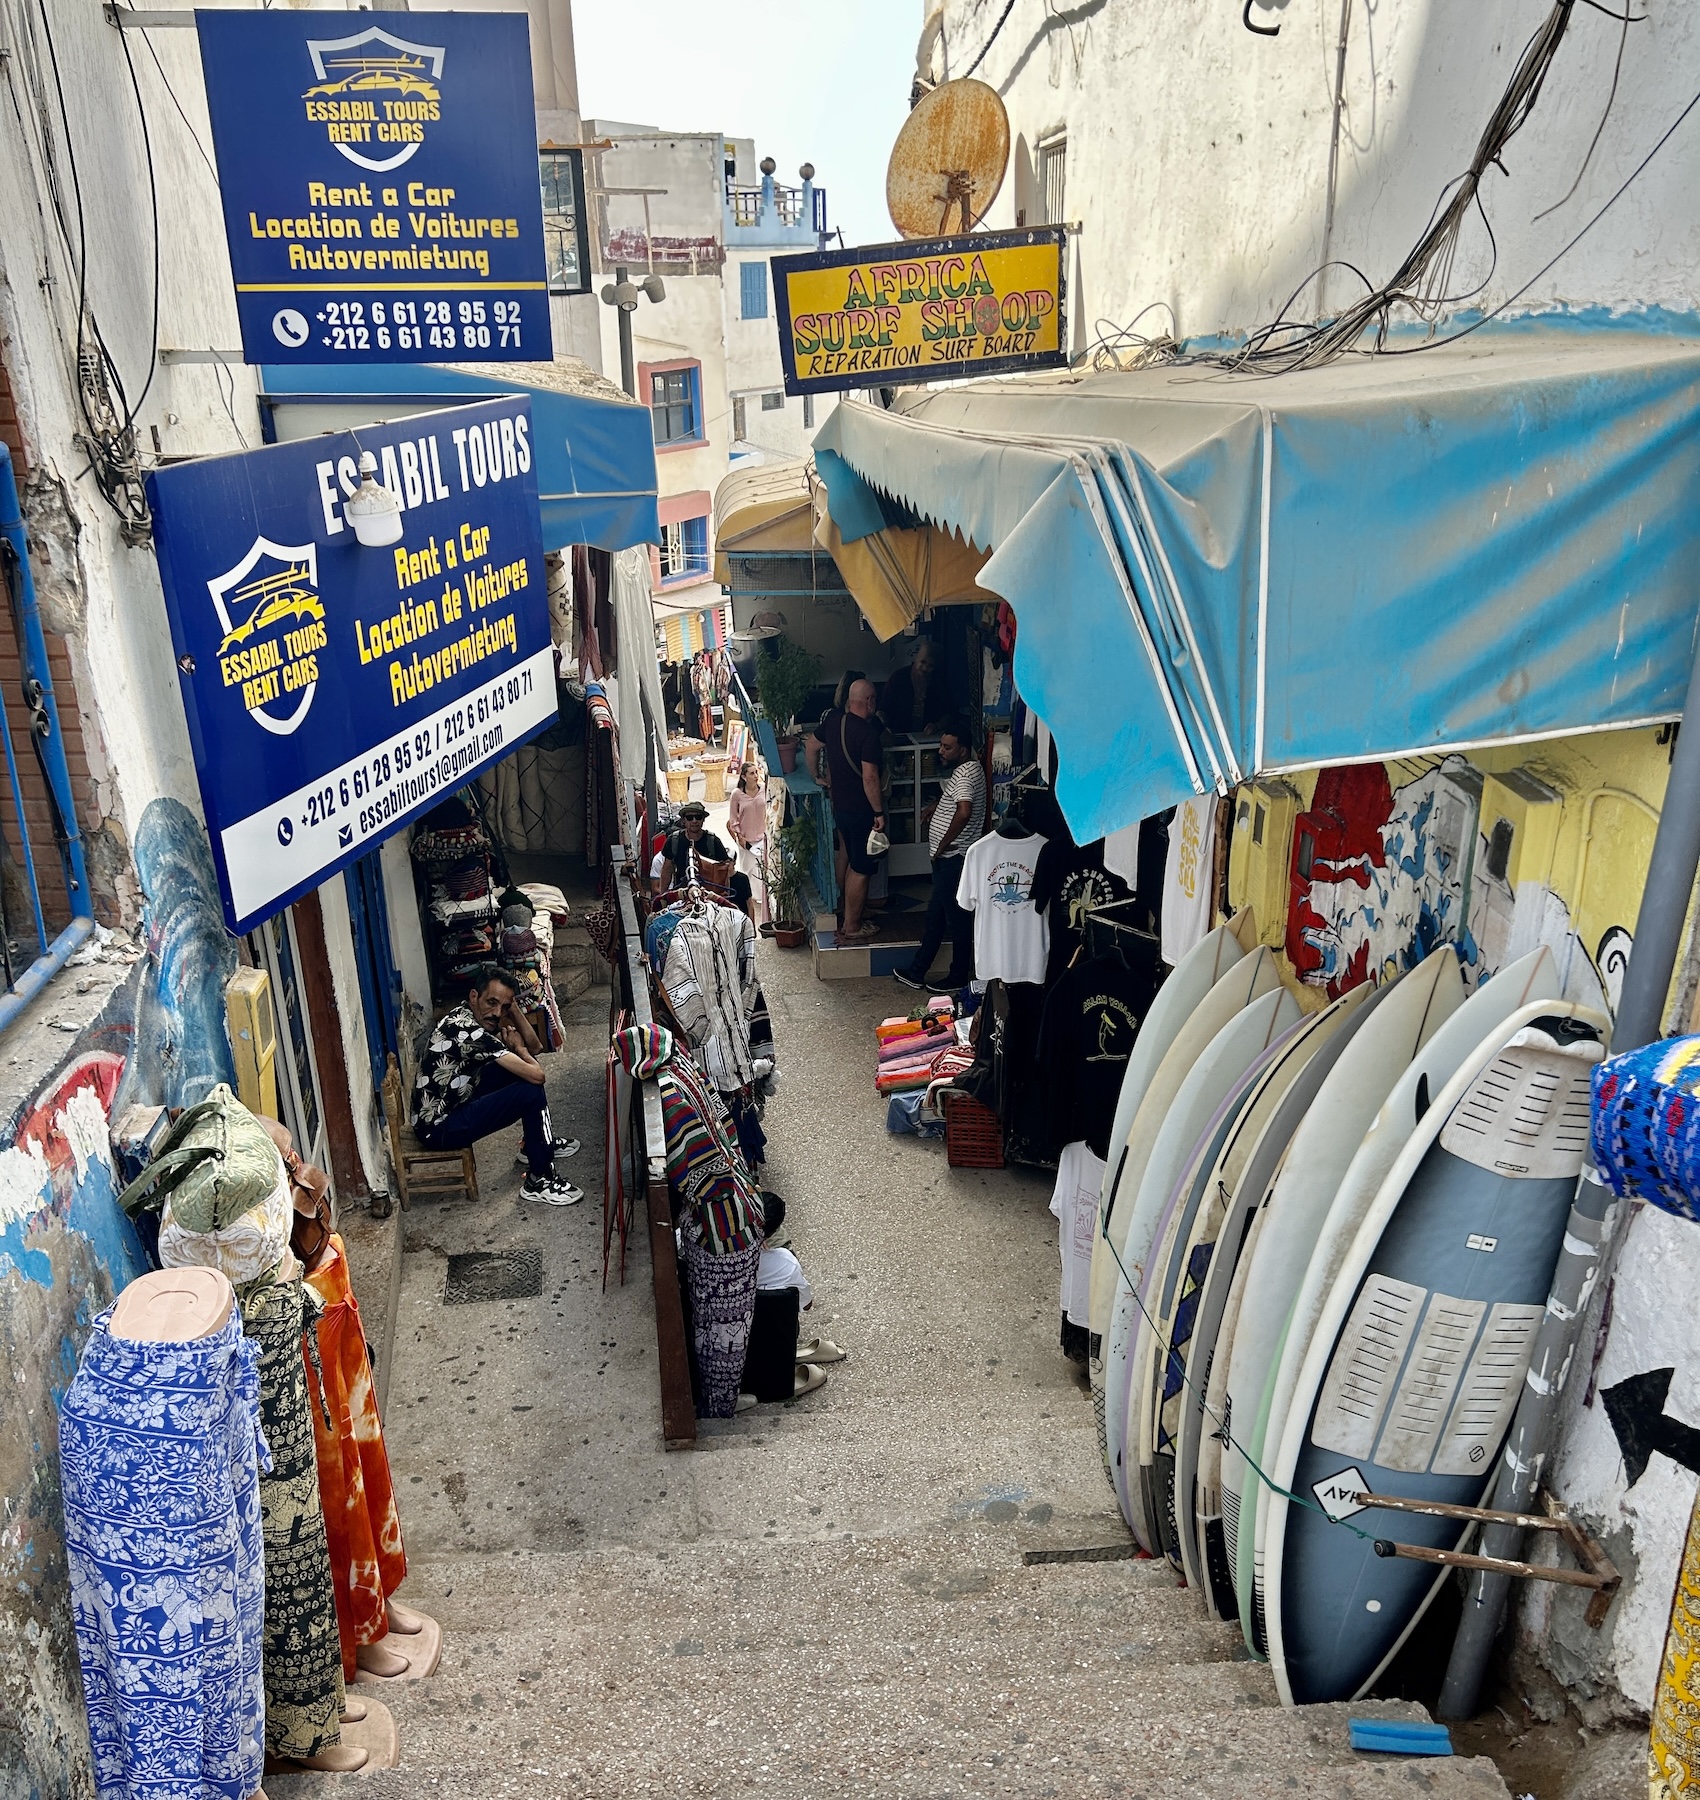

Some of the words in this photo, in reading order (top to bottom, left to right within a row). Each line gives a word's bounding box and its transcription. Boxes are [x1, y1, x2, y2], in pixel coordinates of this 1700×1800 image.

[305, 101, 379, 121] ESSABIL
[384, 102, 441, 121] TOURS
[328, 123, 371, 143] RENT
[378, 123, 424, 142] CARS
[308, 182, 373, 207] Rent
[383, 187, 398, 206] a
[407, 182, 455, 207] Car
[249, 212, 362, 239] Location
[370, 212, 400, 239] de
[408, 212, 519, 239] Voitures
[288, 244, 490, 277] Autovermietung
[843, 254, 994, 310] AFRICA
[316, 302, 365, 326] +212
[371, 304, 386, 325] 6
[392, 302, 417, 325] 61
[424, 302, 451, 325] 28
[458, 301, 486, 325] 95
[493, 301, 522, 325] 92
[794, 305, 901, 355] SURF
[322, 327, 370, 350] +212
[377, 327, 392, 349] 6
[398, 326, 423, 349] 61
[429, 326, 456, 349] 43
[463, 326, 491, 348] 80
[498, 325, 521, 348] 71
[808, 342, 921, 376] REPARATION
[931, 339, 978, 361] SURF
[983, 332, 1036, 356] BOARD
[452, 414, 531, 494] TOURS
[394, 536, 441, 590] Rent
[445, 539, 458, 569] a
[460, 523, 490, 563] Car
[355, 597, 439, 665] Location
[441, 582, 462, 624] de
[464, 558, 529, 612] Voitures
[220, 639, 284, 687] ESSABIL
[283, 621, 328, 661] TOURS
[389, 613, 517, 707] Autovermietung
[242, 670, 280, 710] RENT
[282, 654, 319, 692] CARS
[301, 786, 336, 827] +212
[339, 778, 350, 807] 6
[353, 766, 370, 799] 61
[373, 753, 391, 787] 28
[394, 741, 413, 773] 95
[415, 730, 432, 763] 92
[444, 711, 465, 744] 212
[467, 704, 475, 730] 6
[477, 694, 490, 723] 61
[492, 686, 505, 714] 43
[507, 678, 520, 705] 80
[521, 668, 533, 696] 71
[359, 723, 503, 834] essabiltours1@gmail.com
[1018, 863, 1035, 878] BEAC
[1060, 872, 1079, 901] LOCAL
